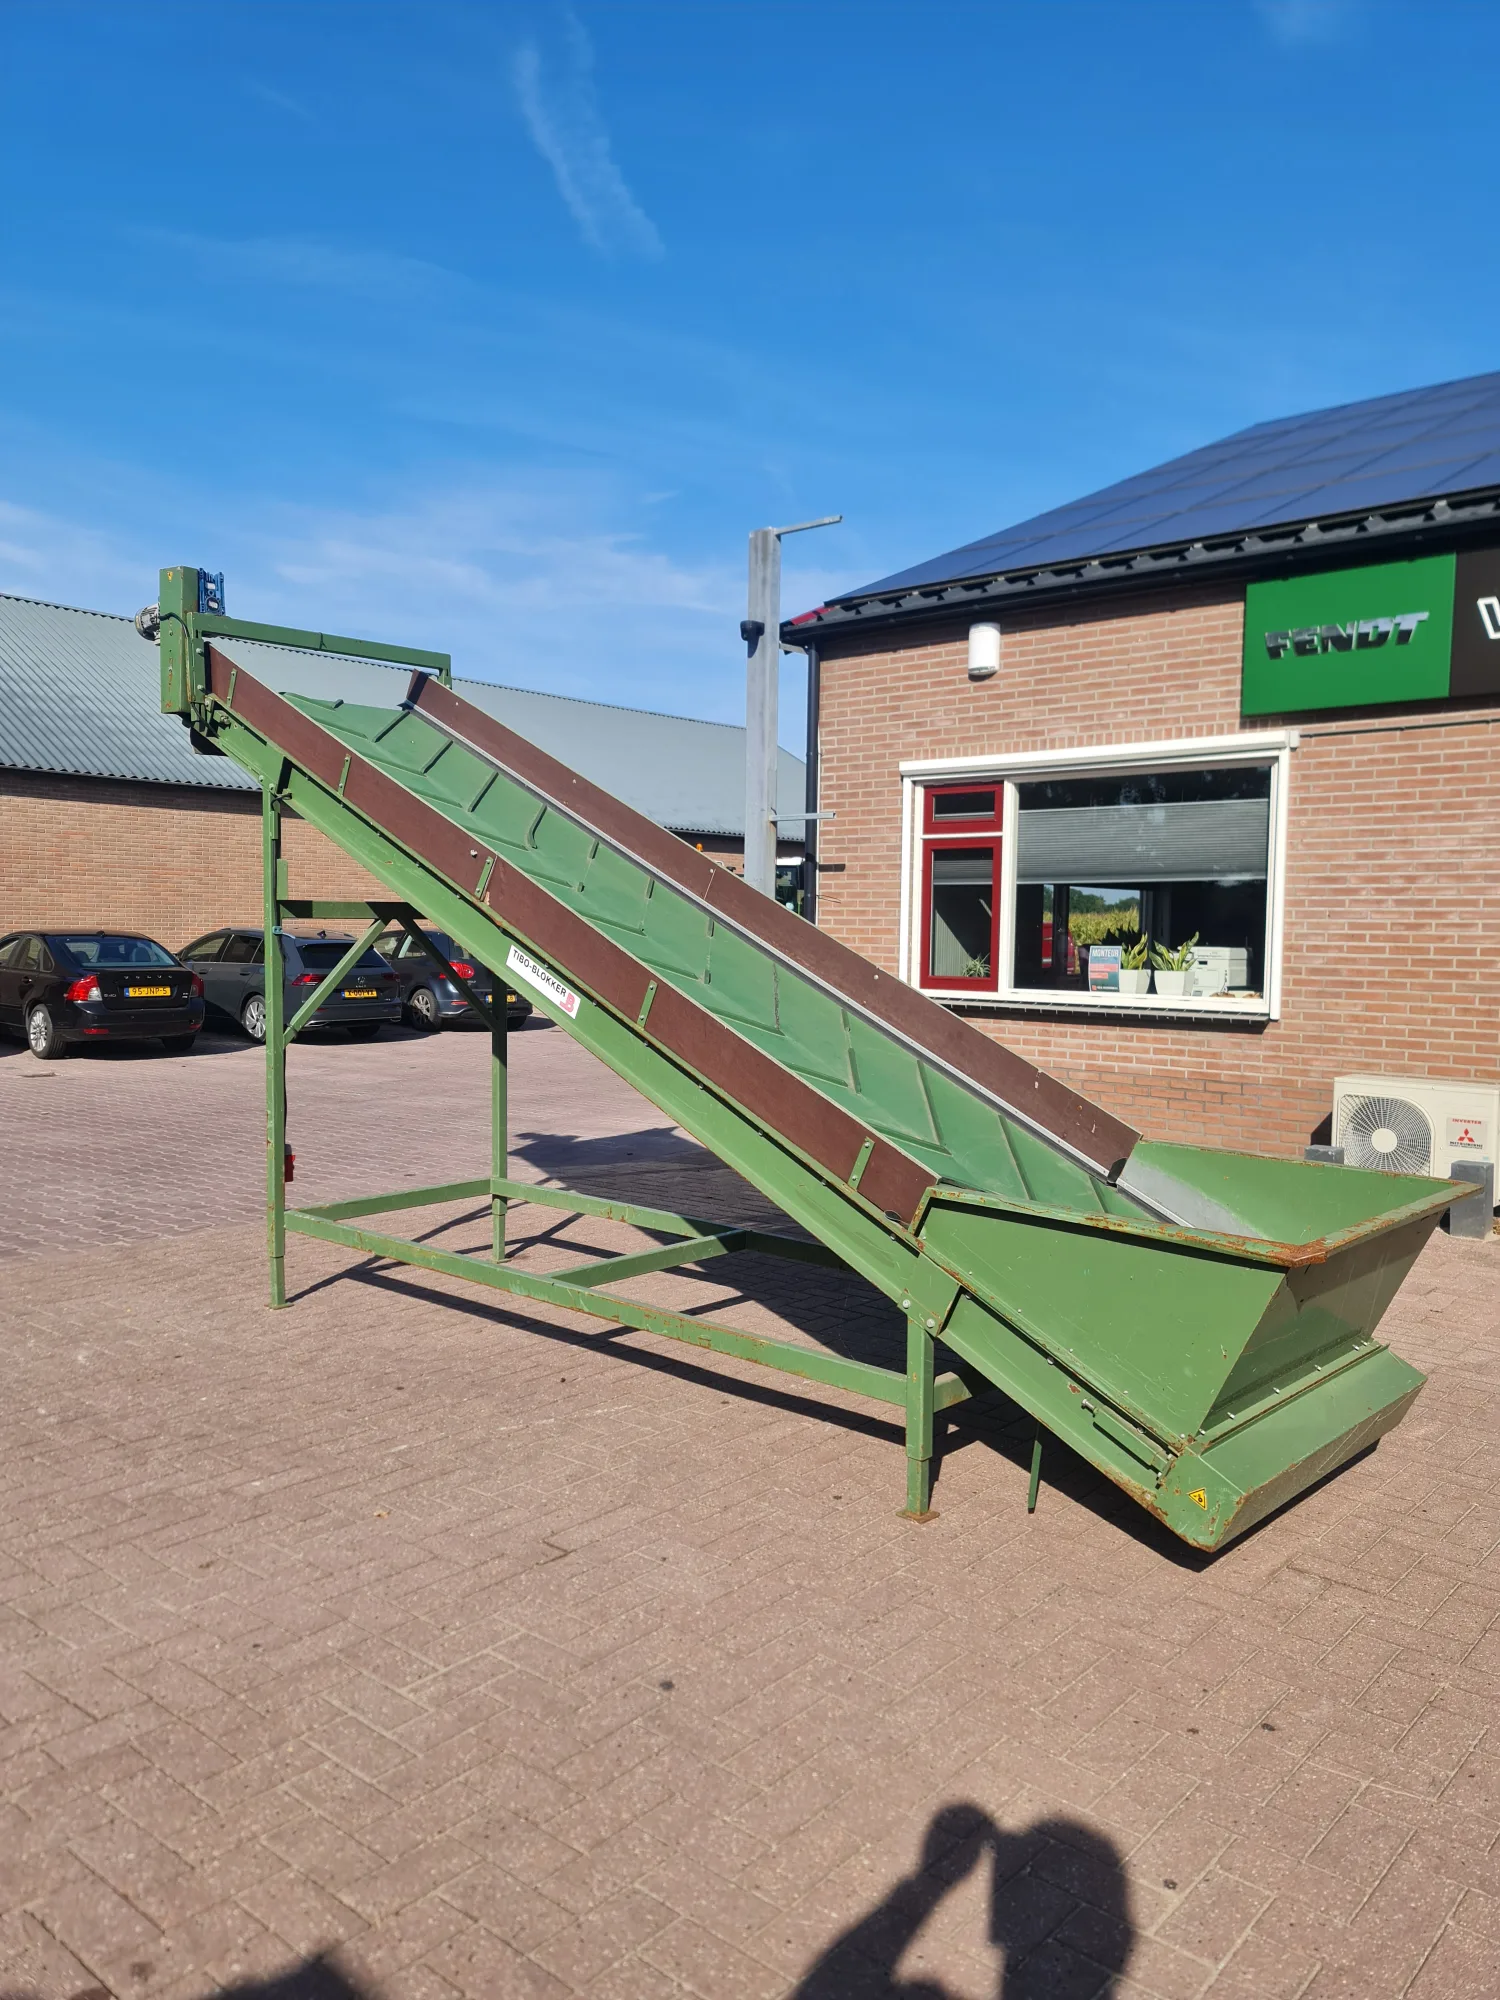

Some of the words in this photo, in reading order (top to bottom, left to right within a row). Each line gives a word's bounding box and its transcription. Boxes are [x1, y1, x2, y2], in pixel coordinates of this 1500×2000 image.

[1264, 611, 1430, 660] FENDT
[1092, 948, 1119, 957] MONTEUR
[513, 949, 567, 997] TIBO-BLOKKER
[131, 987, 168, 996] 95-JNP-5
